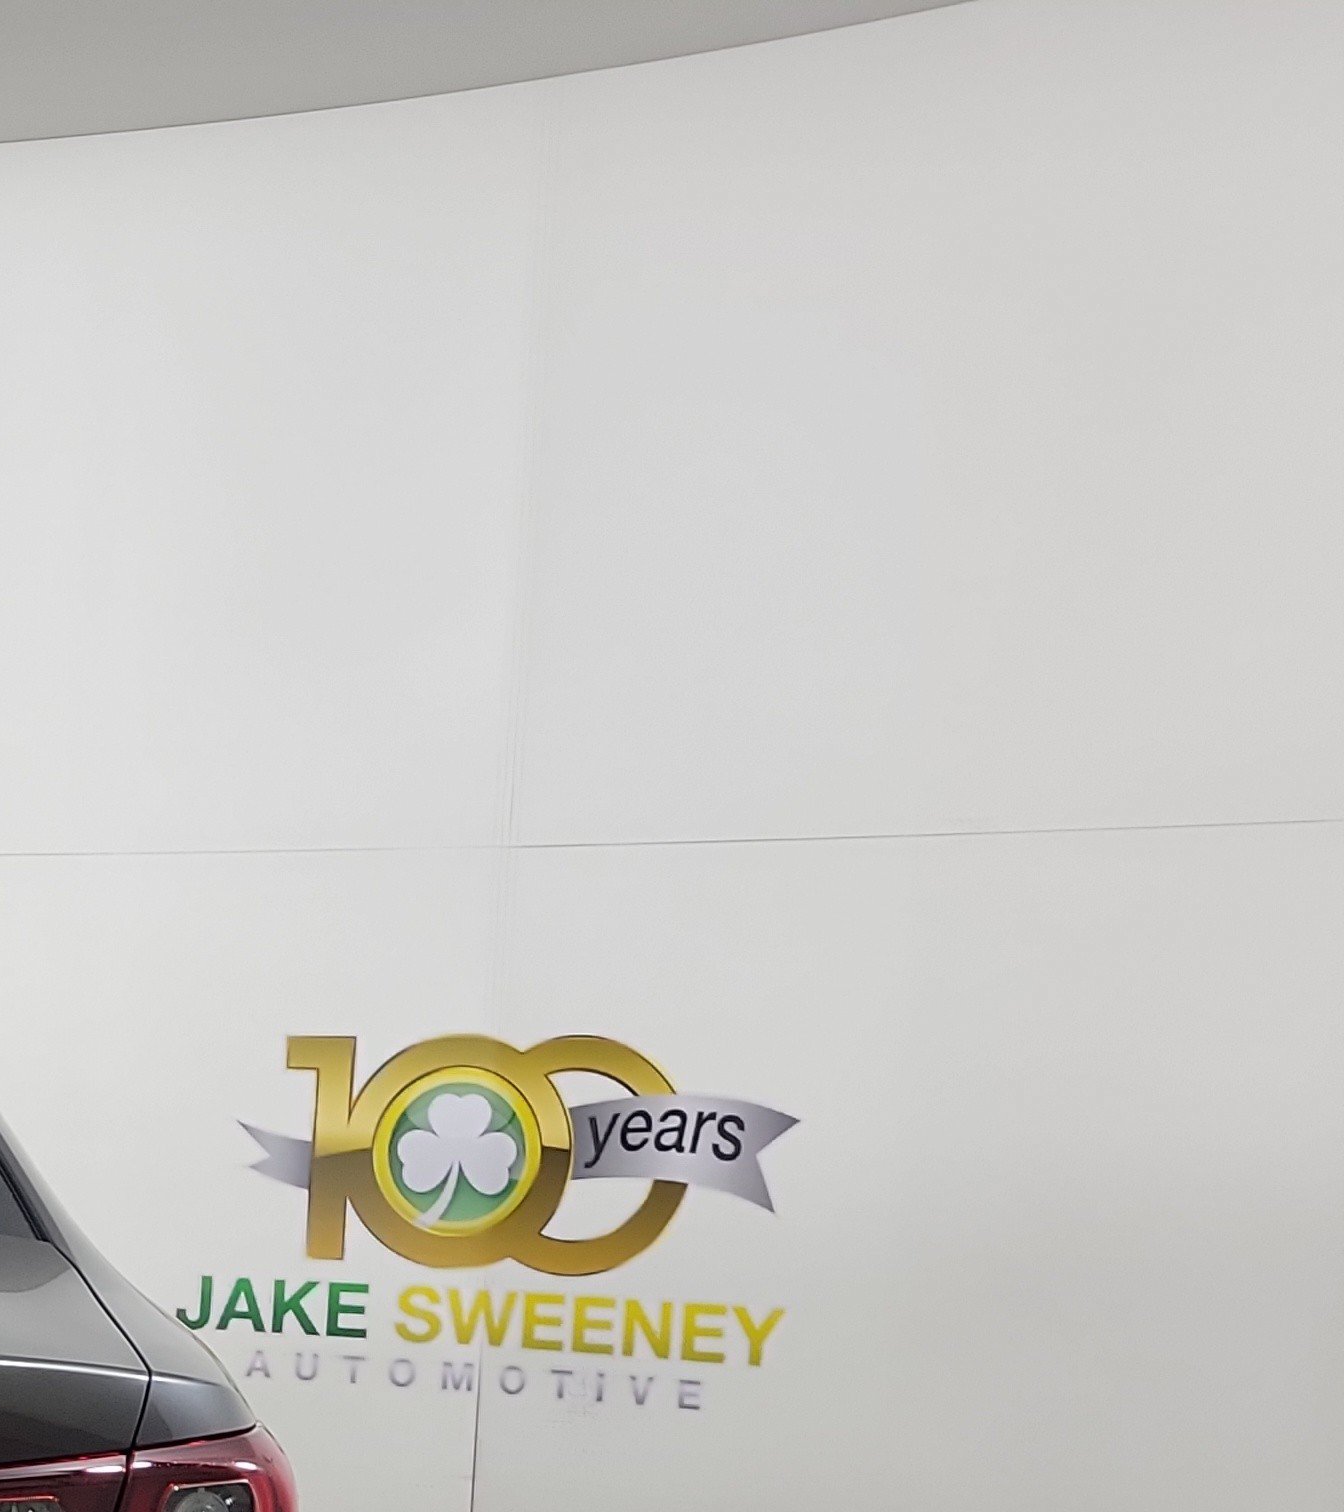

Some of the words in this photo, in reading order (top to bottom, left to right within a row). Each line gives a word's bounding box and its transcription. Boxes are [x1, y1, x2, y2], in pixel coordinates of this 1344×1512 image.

[584, 1107, 745, 1168] years
[176, 1275, 369, 1338] JAKE
[395, 1284, 786, 1366] SWEENEY
[245, 1350, 701, 1411] AUTOMOTIVE
